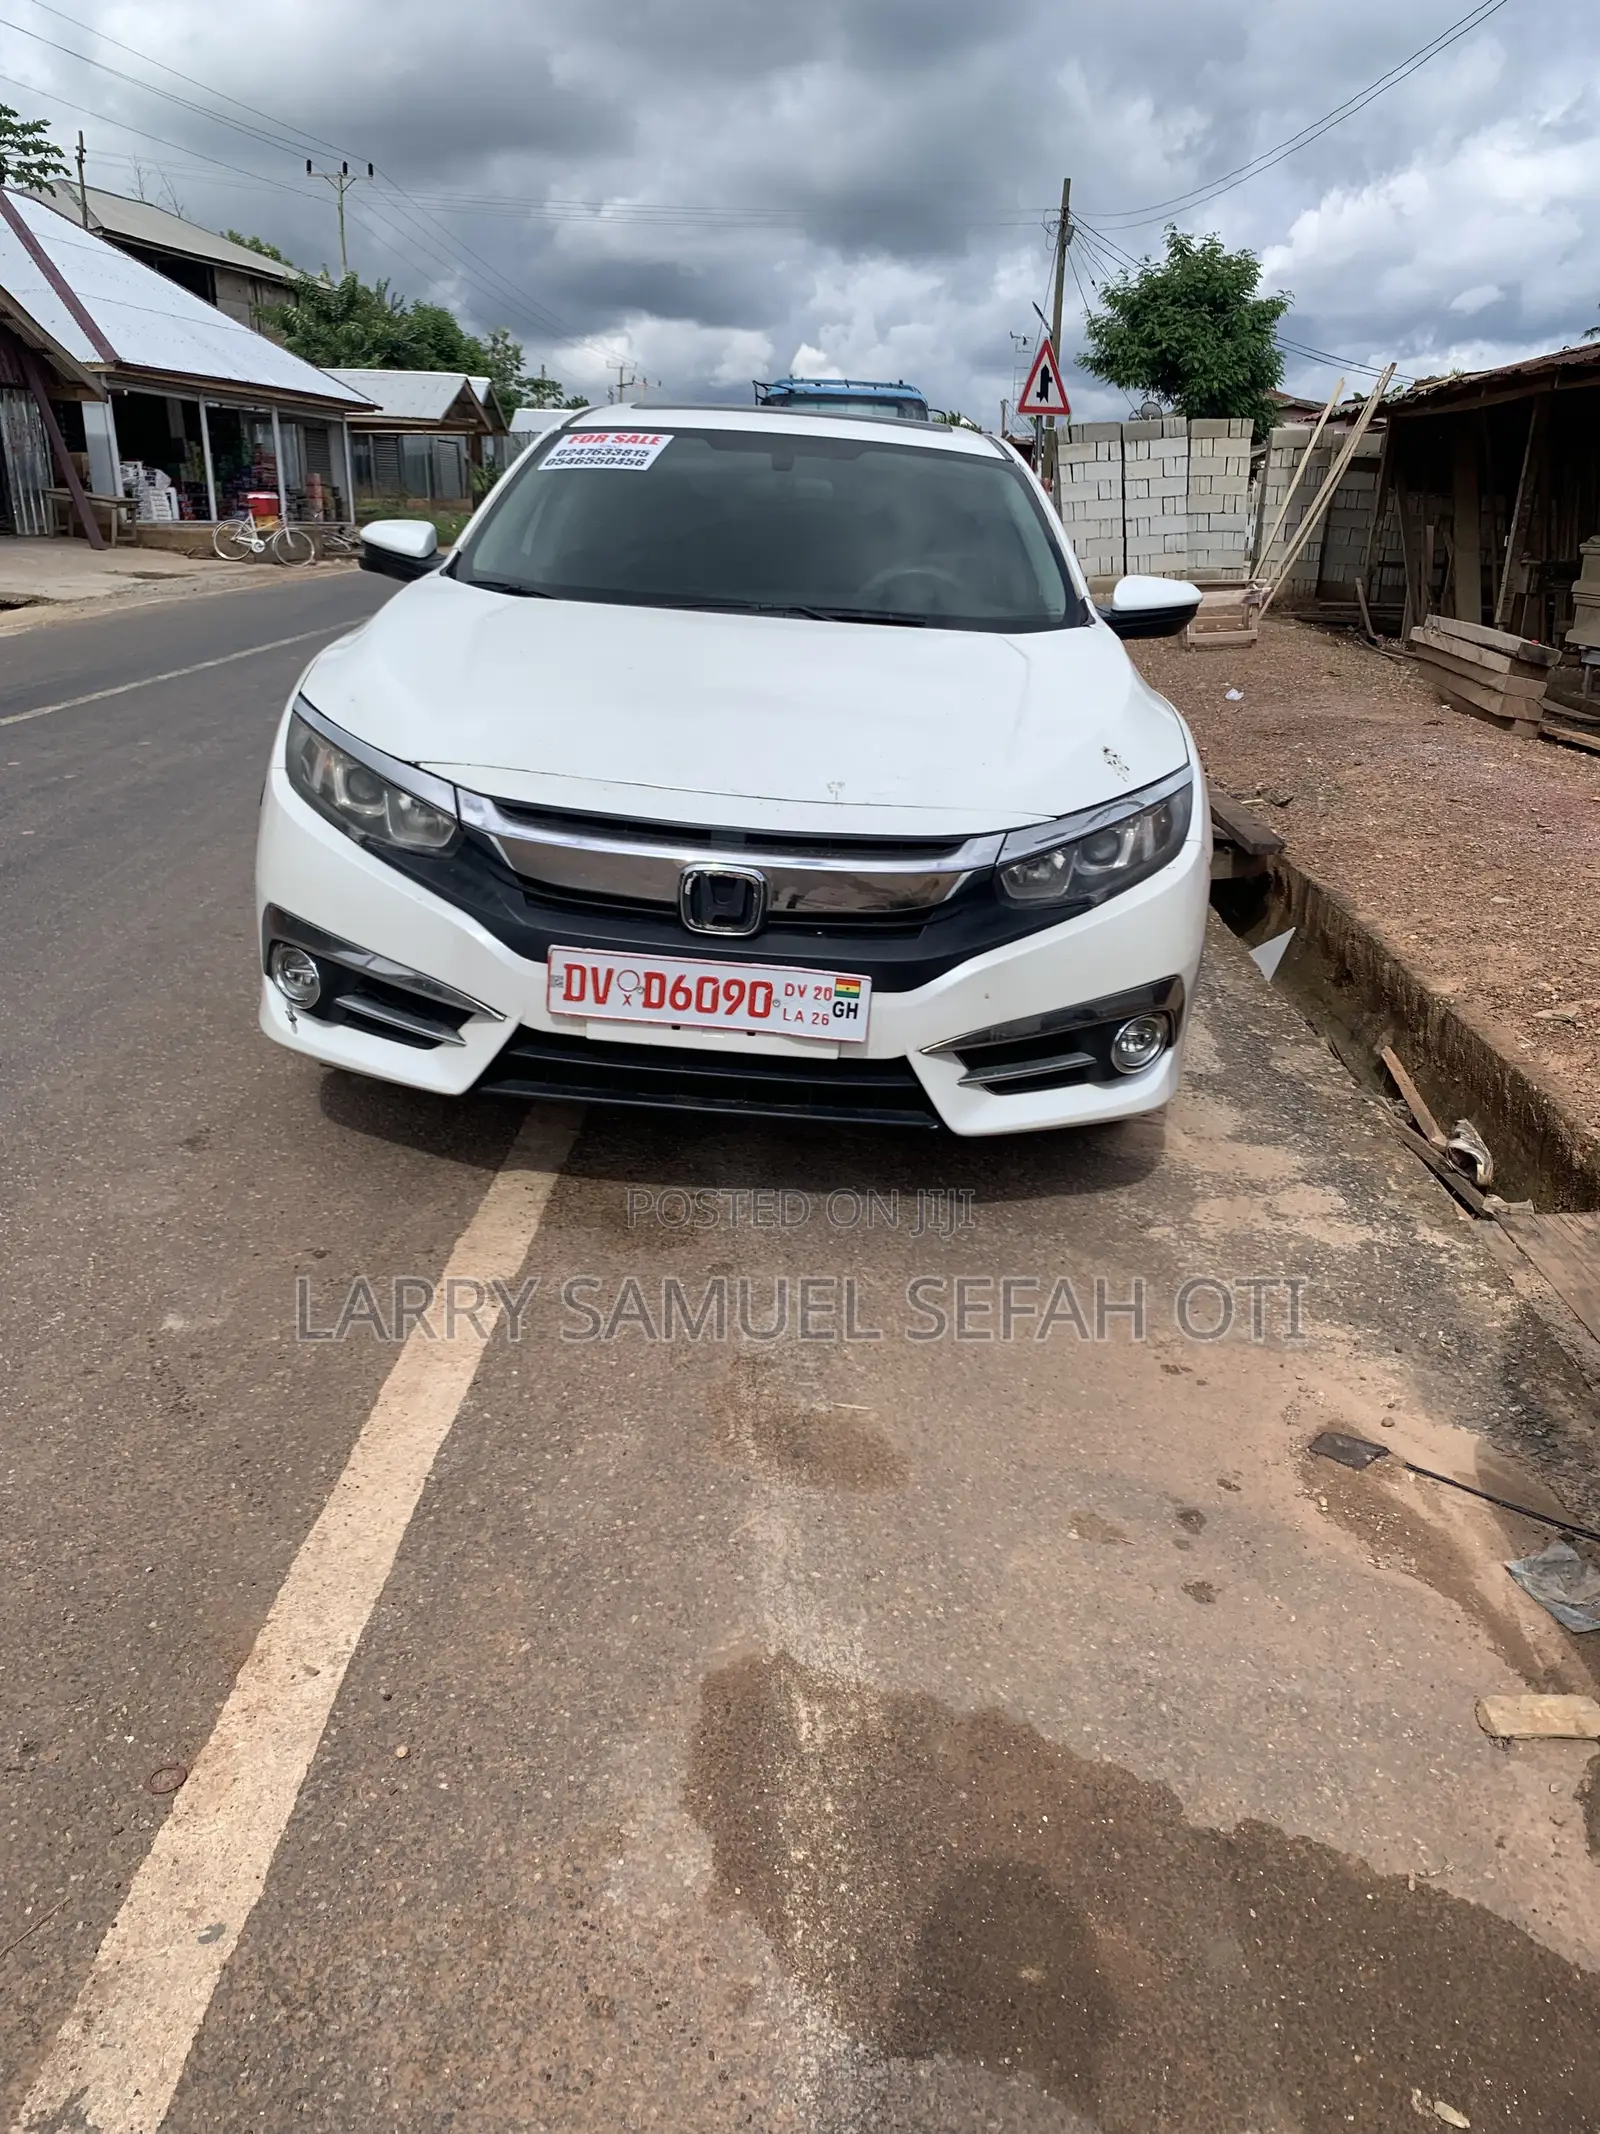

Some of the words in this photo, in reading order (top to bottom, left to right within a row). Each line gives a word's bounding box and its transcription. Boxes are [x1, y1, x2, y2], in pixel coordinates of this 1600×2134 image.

[568, 434, 608, 445] FOR
[611, 434, 664, 446] SALE
[544, 457, 647, 467] 0546550456
[563, 963, 614, 1005] DV
[642, 971, 773, 1019] D6090
[784, 982, 808, 998] DV
[813, 985, 833, 1002] 20
[783, 1007, 804, 1024] LA
[811, 1012, 829, 1026] 26
[832, 1000, 859, 1020] GH
